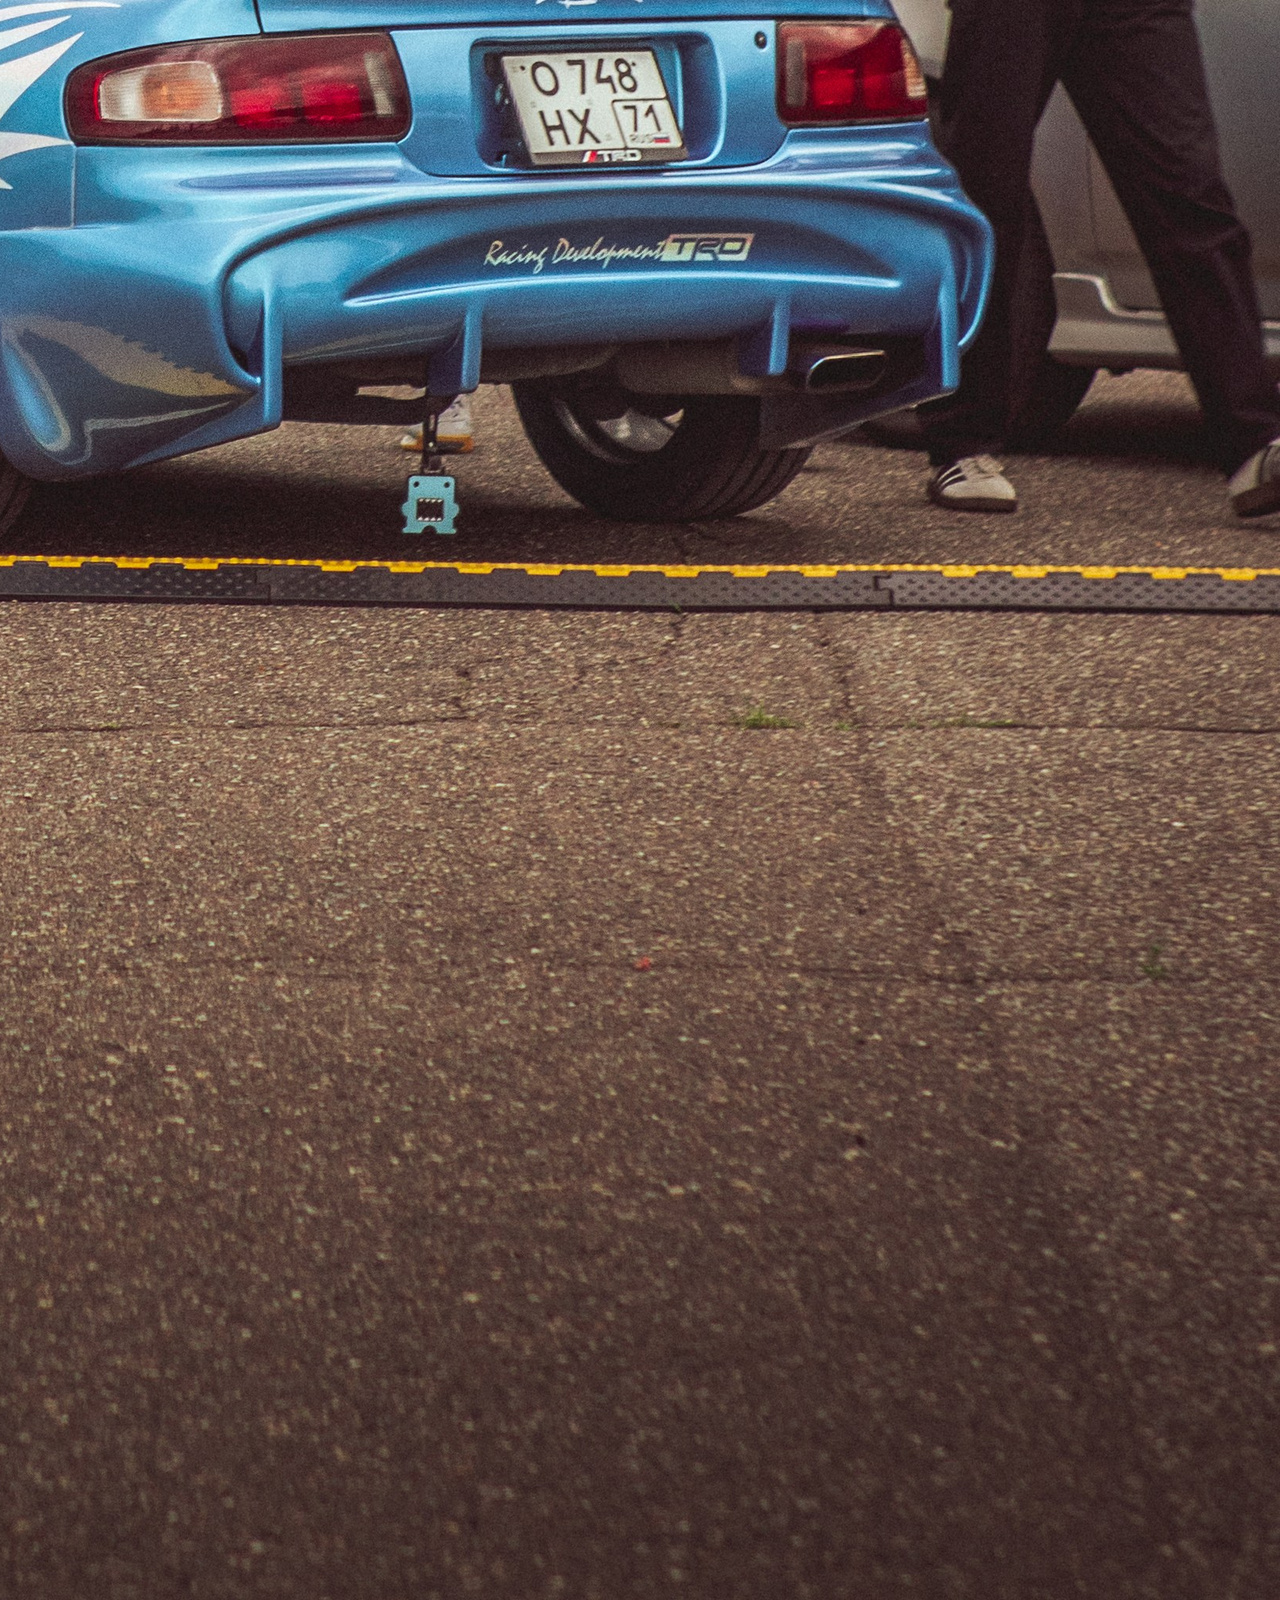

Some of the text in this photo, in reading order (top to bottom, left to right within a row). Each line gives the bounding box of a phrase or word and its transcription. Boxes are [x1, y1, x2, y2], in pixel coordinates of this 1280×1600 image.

[538, 104, 662, 146] HX 71
[483, 240, 549, 275] Racing
[551, 236, 666, 269] Development
